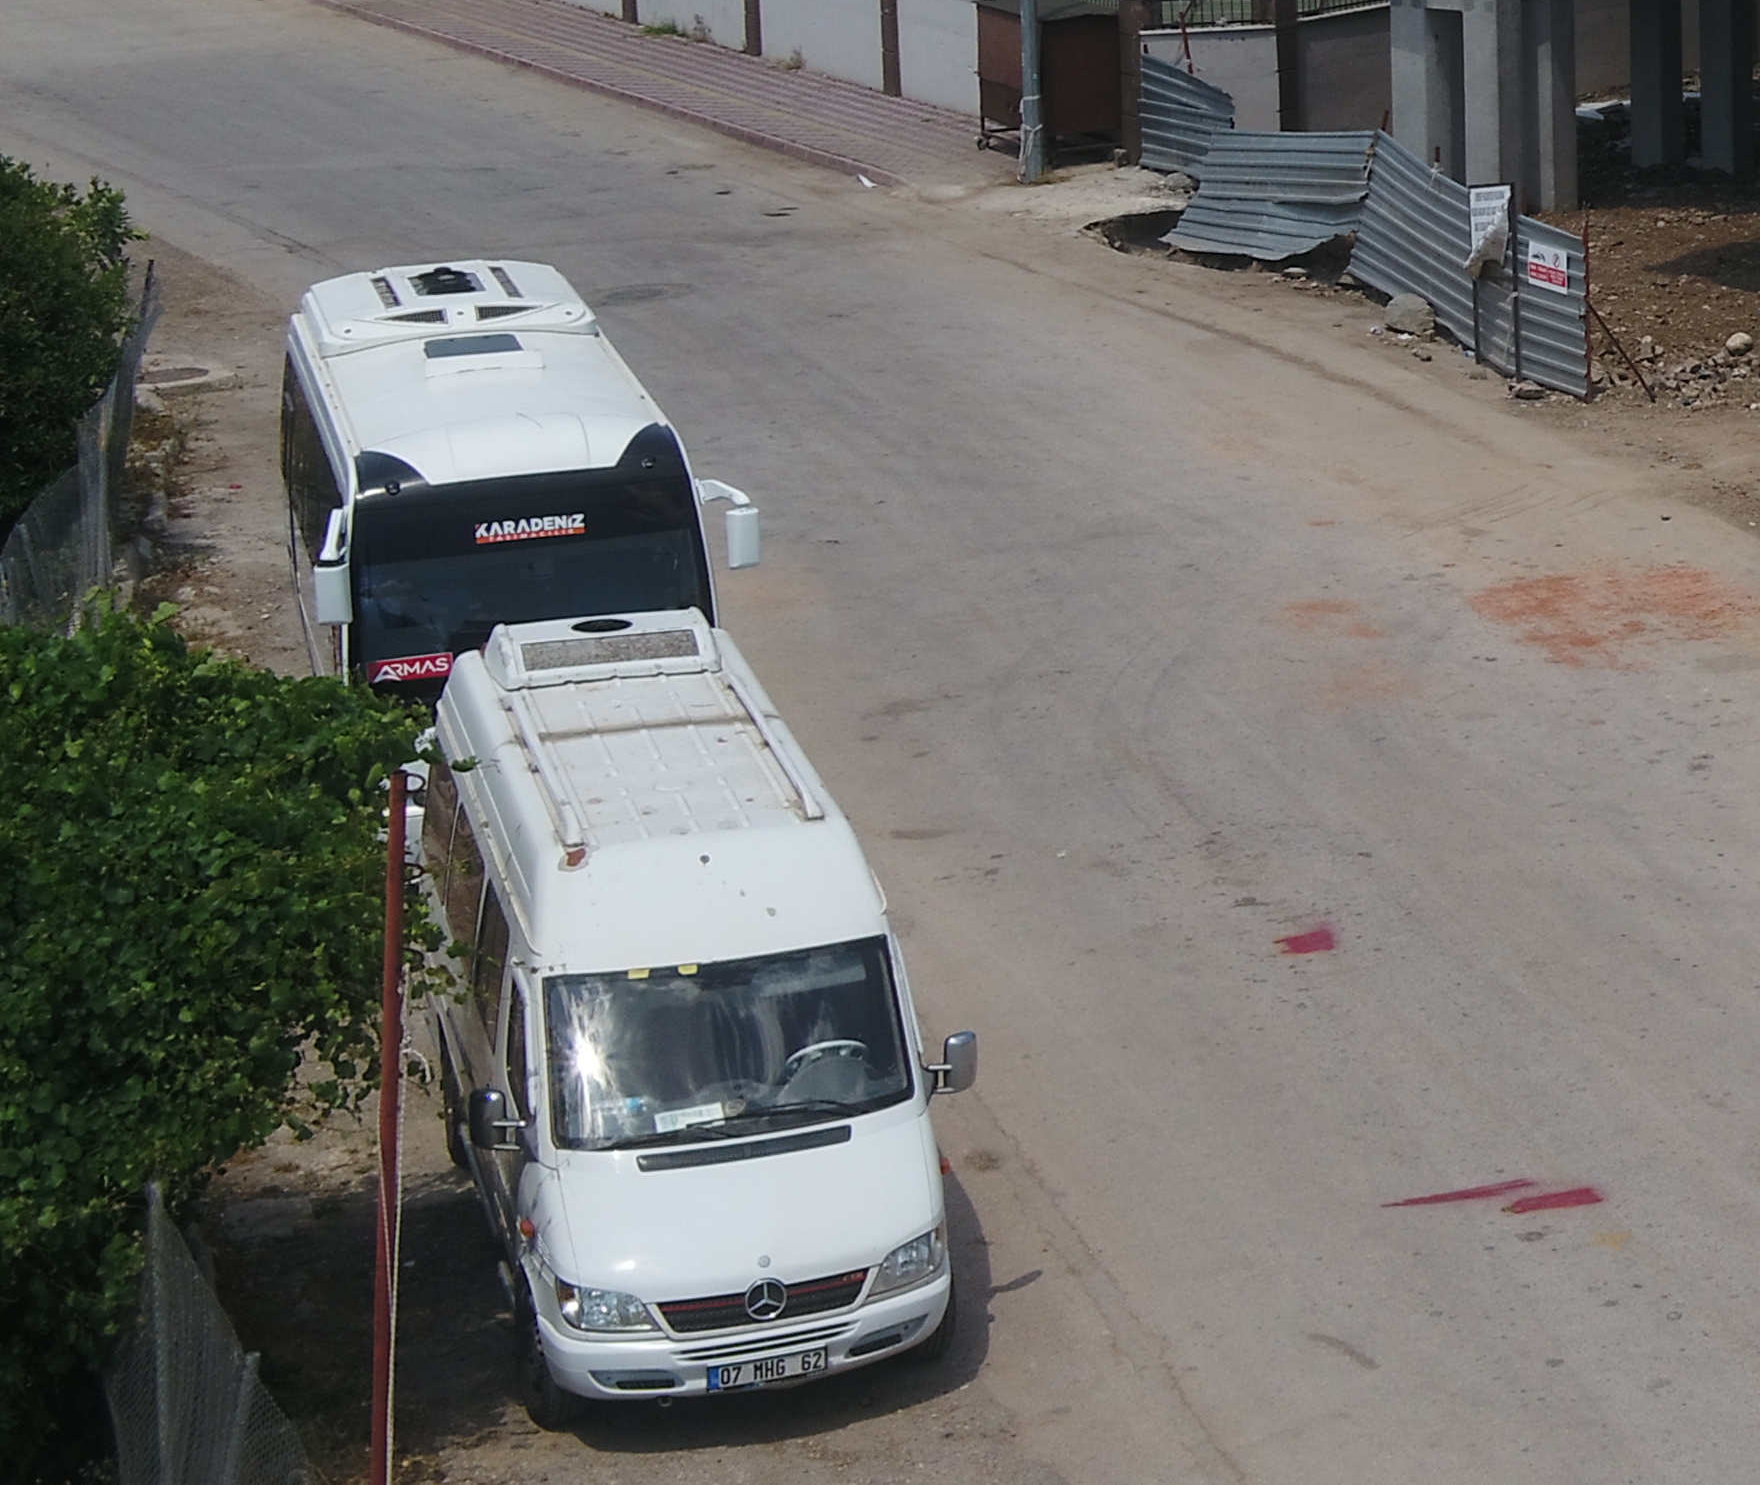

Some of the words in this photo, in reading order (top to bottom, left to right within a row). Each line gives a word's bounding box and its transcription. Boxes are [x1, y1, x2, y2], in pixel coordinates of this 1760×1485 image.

[475, 513, 585, 539] KARADENİZ
[373, 657, 450, 683] ARMAS
[720, 1365, 742, 1385] 07
[753, 1359, 786, 1381] MHG
[801, 1351, 822, 1371] 62
